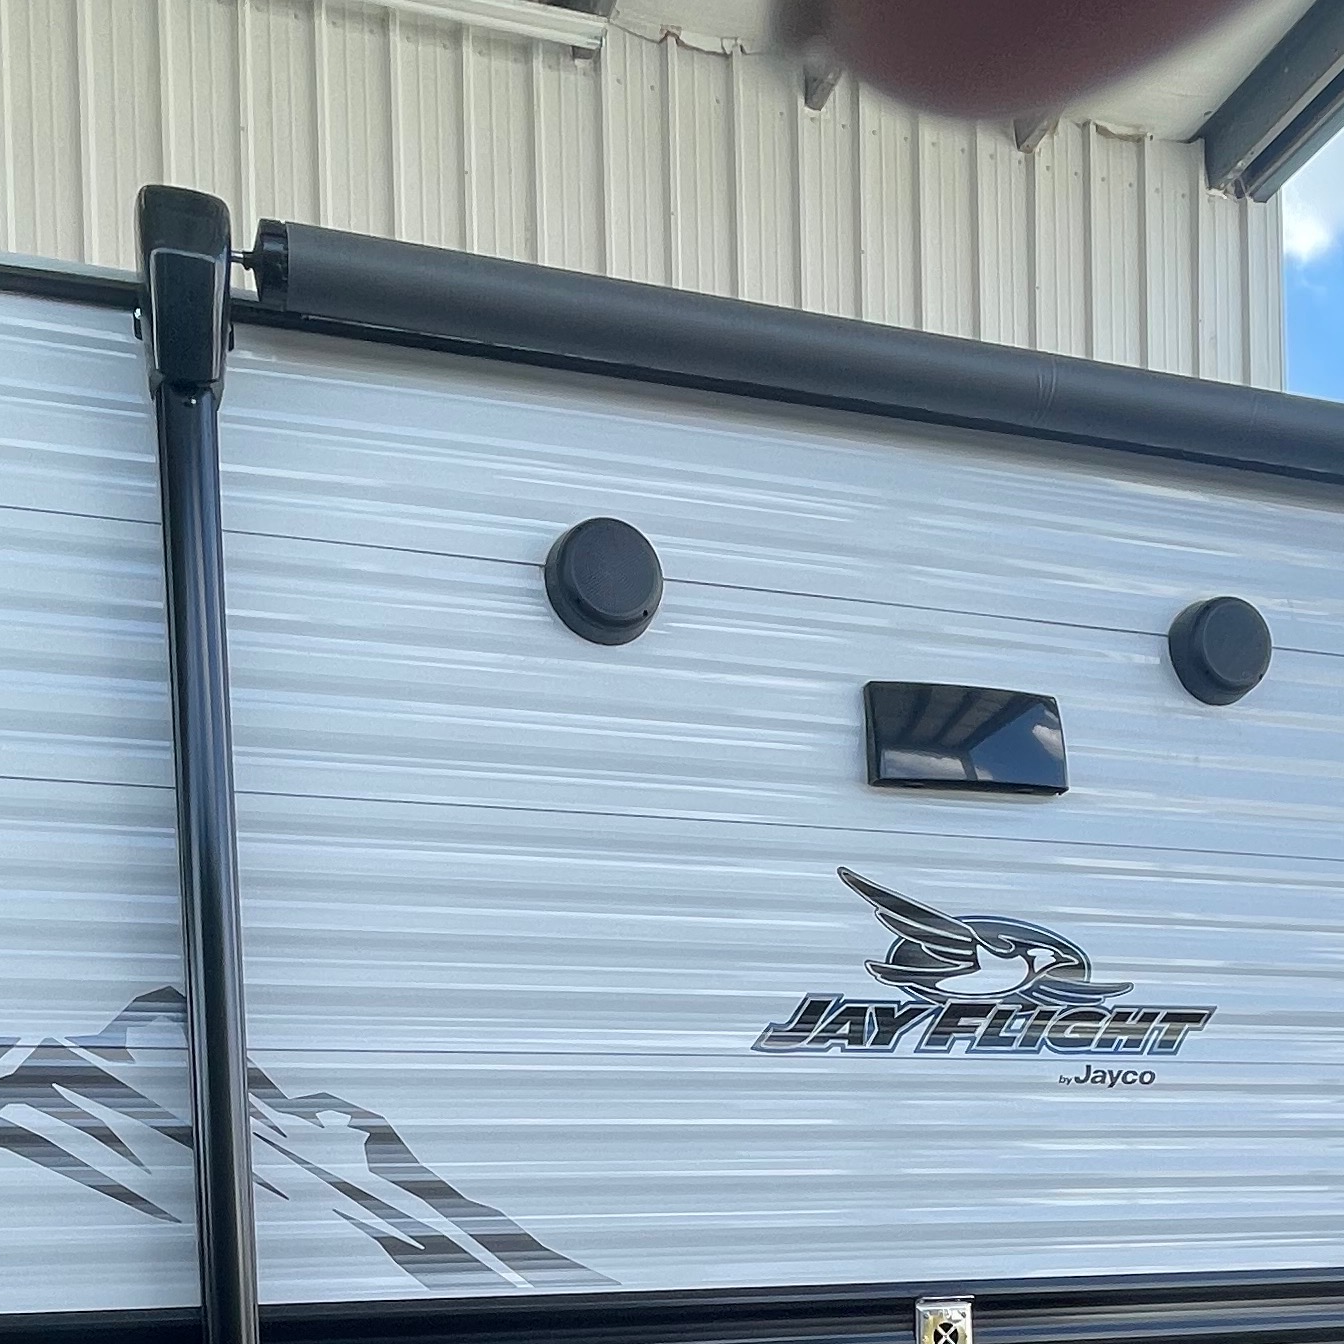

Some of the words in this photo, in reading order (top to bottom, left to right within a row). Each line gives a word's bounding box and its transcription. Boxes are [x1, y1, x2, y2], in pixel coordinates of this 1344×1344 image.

[751, 992, 933, 1054] JAY
[915, 998, 1217, 1056] FLIGHT
[1058, 1074, 1072, 1086] by
[1074, 1064, 1157, 1088] Jayco
